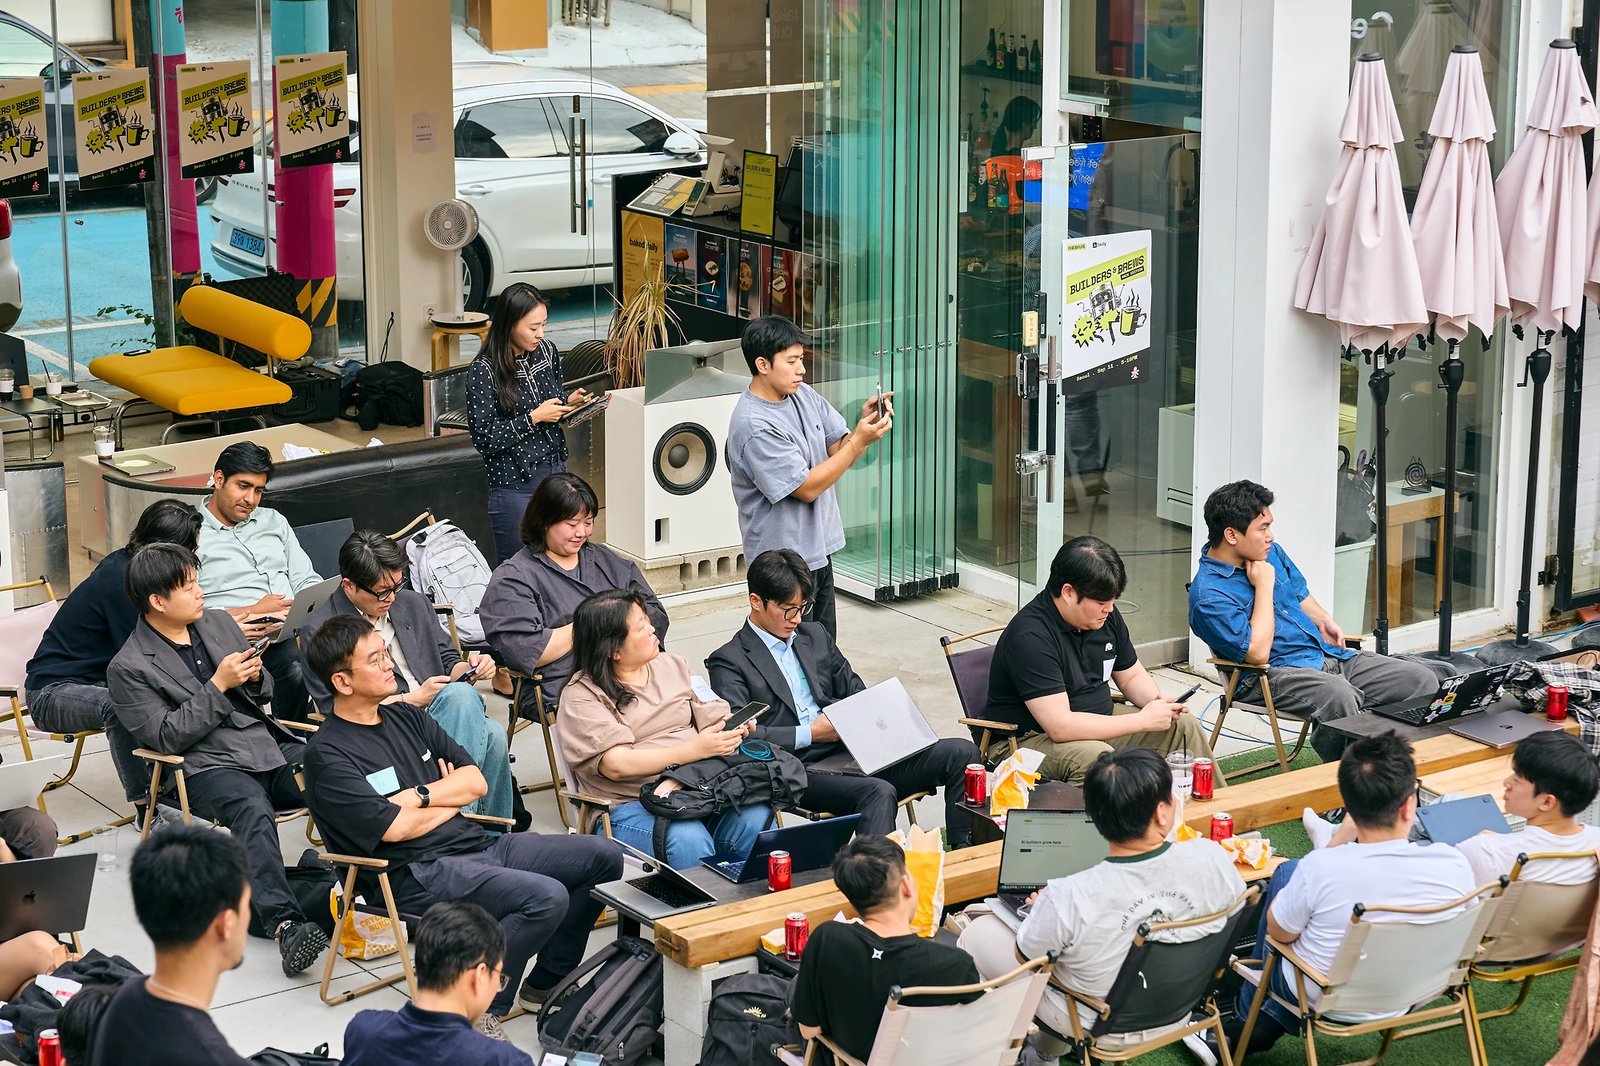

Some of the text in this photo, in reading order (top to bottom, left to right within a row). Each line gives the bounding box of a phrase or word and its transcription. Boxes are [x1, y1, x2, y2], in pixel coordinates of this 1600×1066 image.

[184, 86, 220, 106] BUILDERS
[224, 78, 246, 92] BREWS
[282, 78, 317, 96] BUILDERS
[322, 68, 342, 82] BREWS
[16, 96, 39, 110] BREWS
[81, 95, 117, 115] BUILDERS
[122, 85, 144, 100] BREWS
[630, 238, 658, 253] baked aily
[1069, 255, 1144, 296] BUILDERS & BREWS
[1129, 898, 1144, 913] DAY
[1160, 890, 1178, 898] THE
